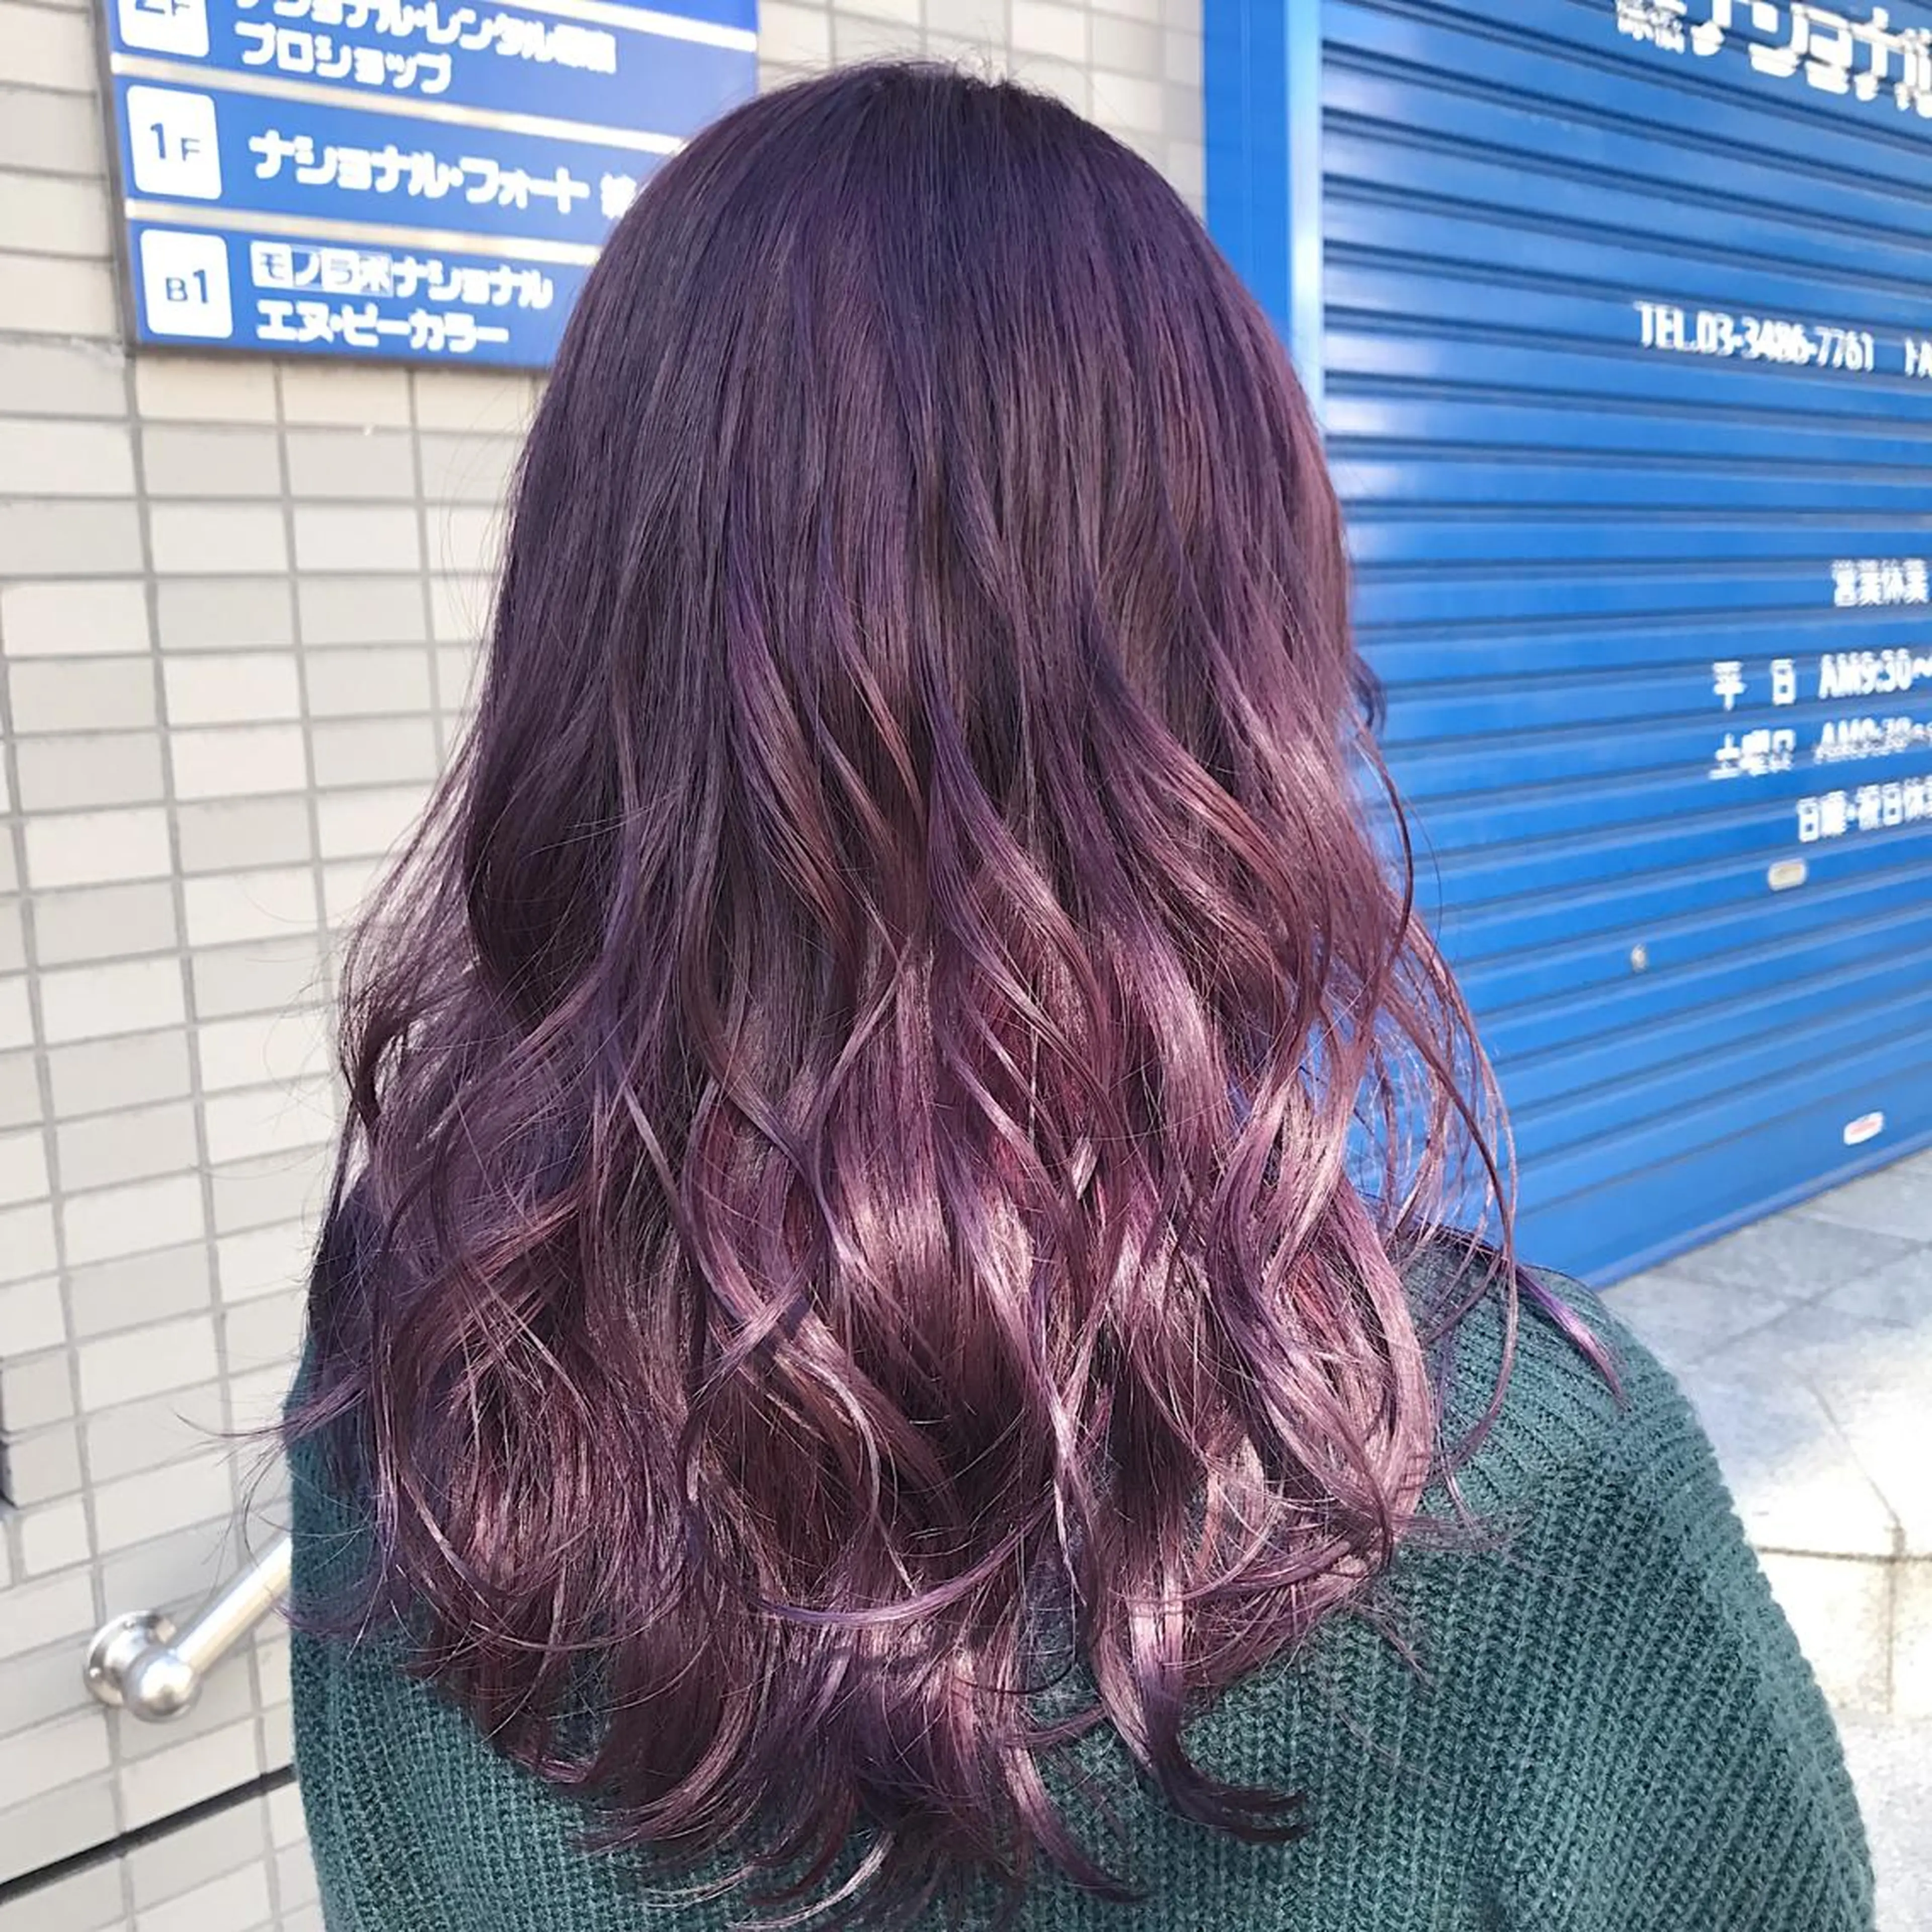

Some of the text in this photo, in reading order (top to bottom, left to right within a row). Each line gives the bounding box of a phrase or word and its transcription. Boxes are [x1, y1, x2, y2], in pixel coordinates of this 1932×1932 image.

[234, 22, 452, 94] プロショップ
[150, 123, 201, 162] 1F
[165, 268, 208, 304] B1
